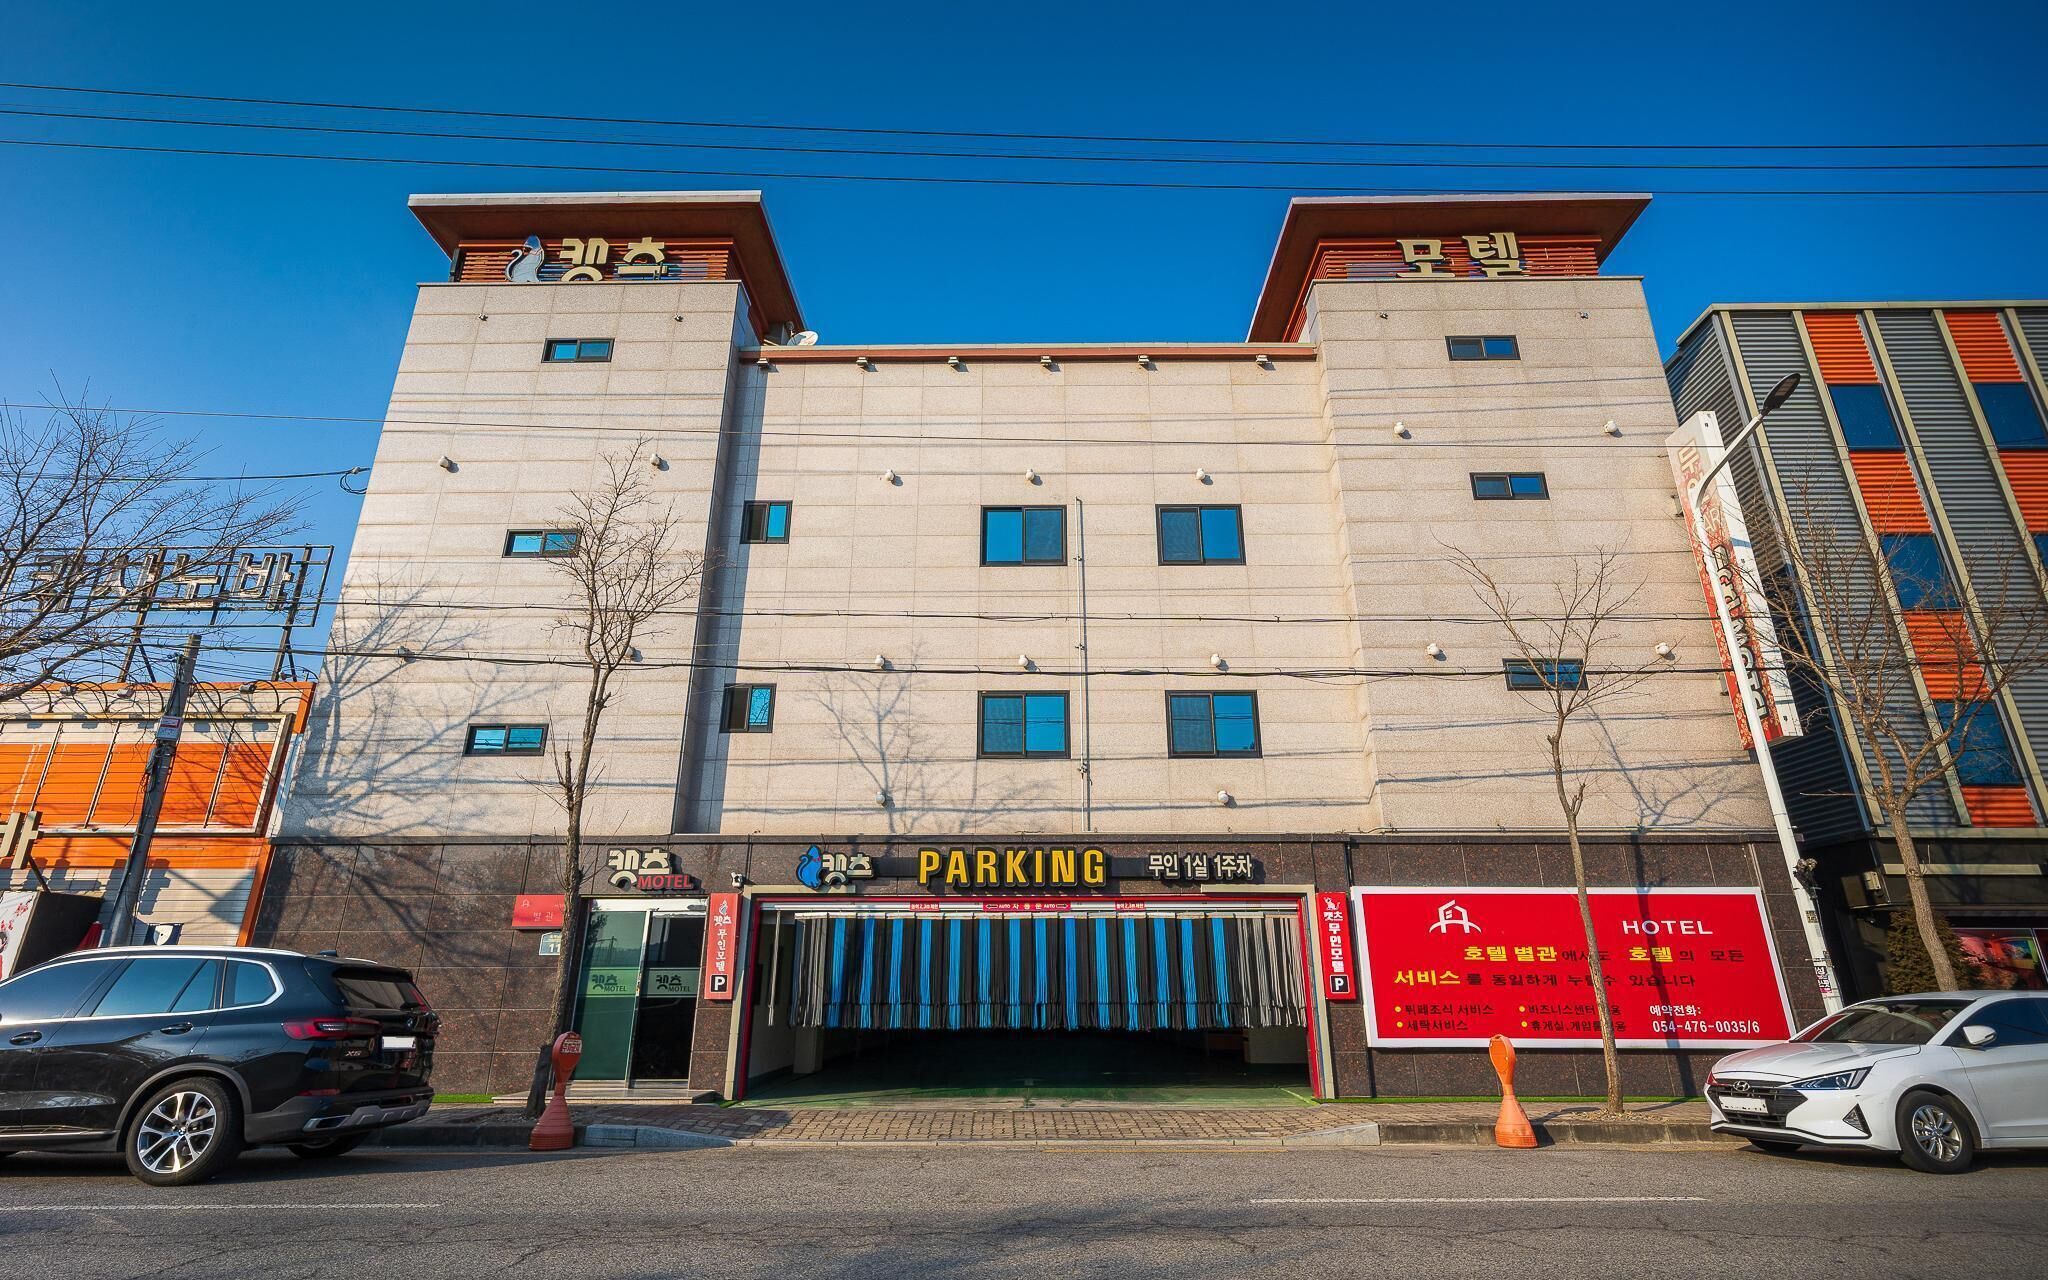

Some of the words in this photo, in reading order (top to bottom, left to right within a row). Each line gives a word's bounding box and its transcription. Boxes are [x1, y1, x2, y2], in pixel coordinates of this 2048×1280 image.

[1396, 232, 1524, 278] 모텔
[919, 849, 1106, 884] PARKING
[1148, 854, 1180, 878] 무인
[1184, 855, 1208, 879] 1실
[1213, 854, 1253, 879] 1주차
[637, 874, 693, 890] MOTEL
[1622, 920, 1713, 935] HOTEL
[716, 928, 728, 972] 무인모텔
[1328, 923, 1344, 972] 무인모텔
[1464, 946, 1508, 962] 호텔
[1629, 946, 1674, 962] 호텔
[1710, 949, 1744, 961] 모든
[714, 976, 726, 990] P
[1335, 977, 1344, 990] P
[1491, 973, 1558, 986] 동일하게
[1628, 975, 1695, 987] 있습니다
[1457, 1004, 1495, 1016] 서비스
[1649, 1004, 1701, 1017] 예약전화:
[1652, 1020, 1760, 1033] 054-476-0035/6
